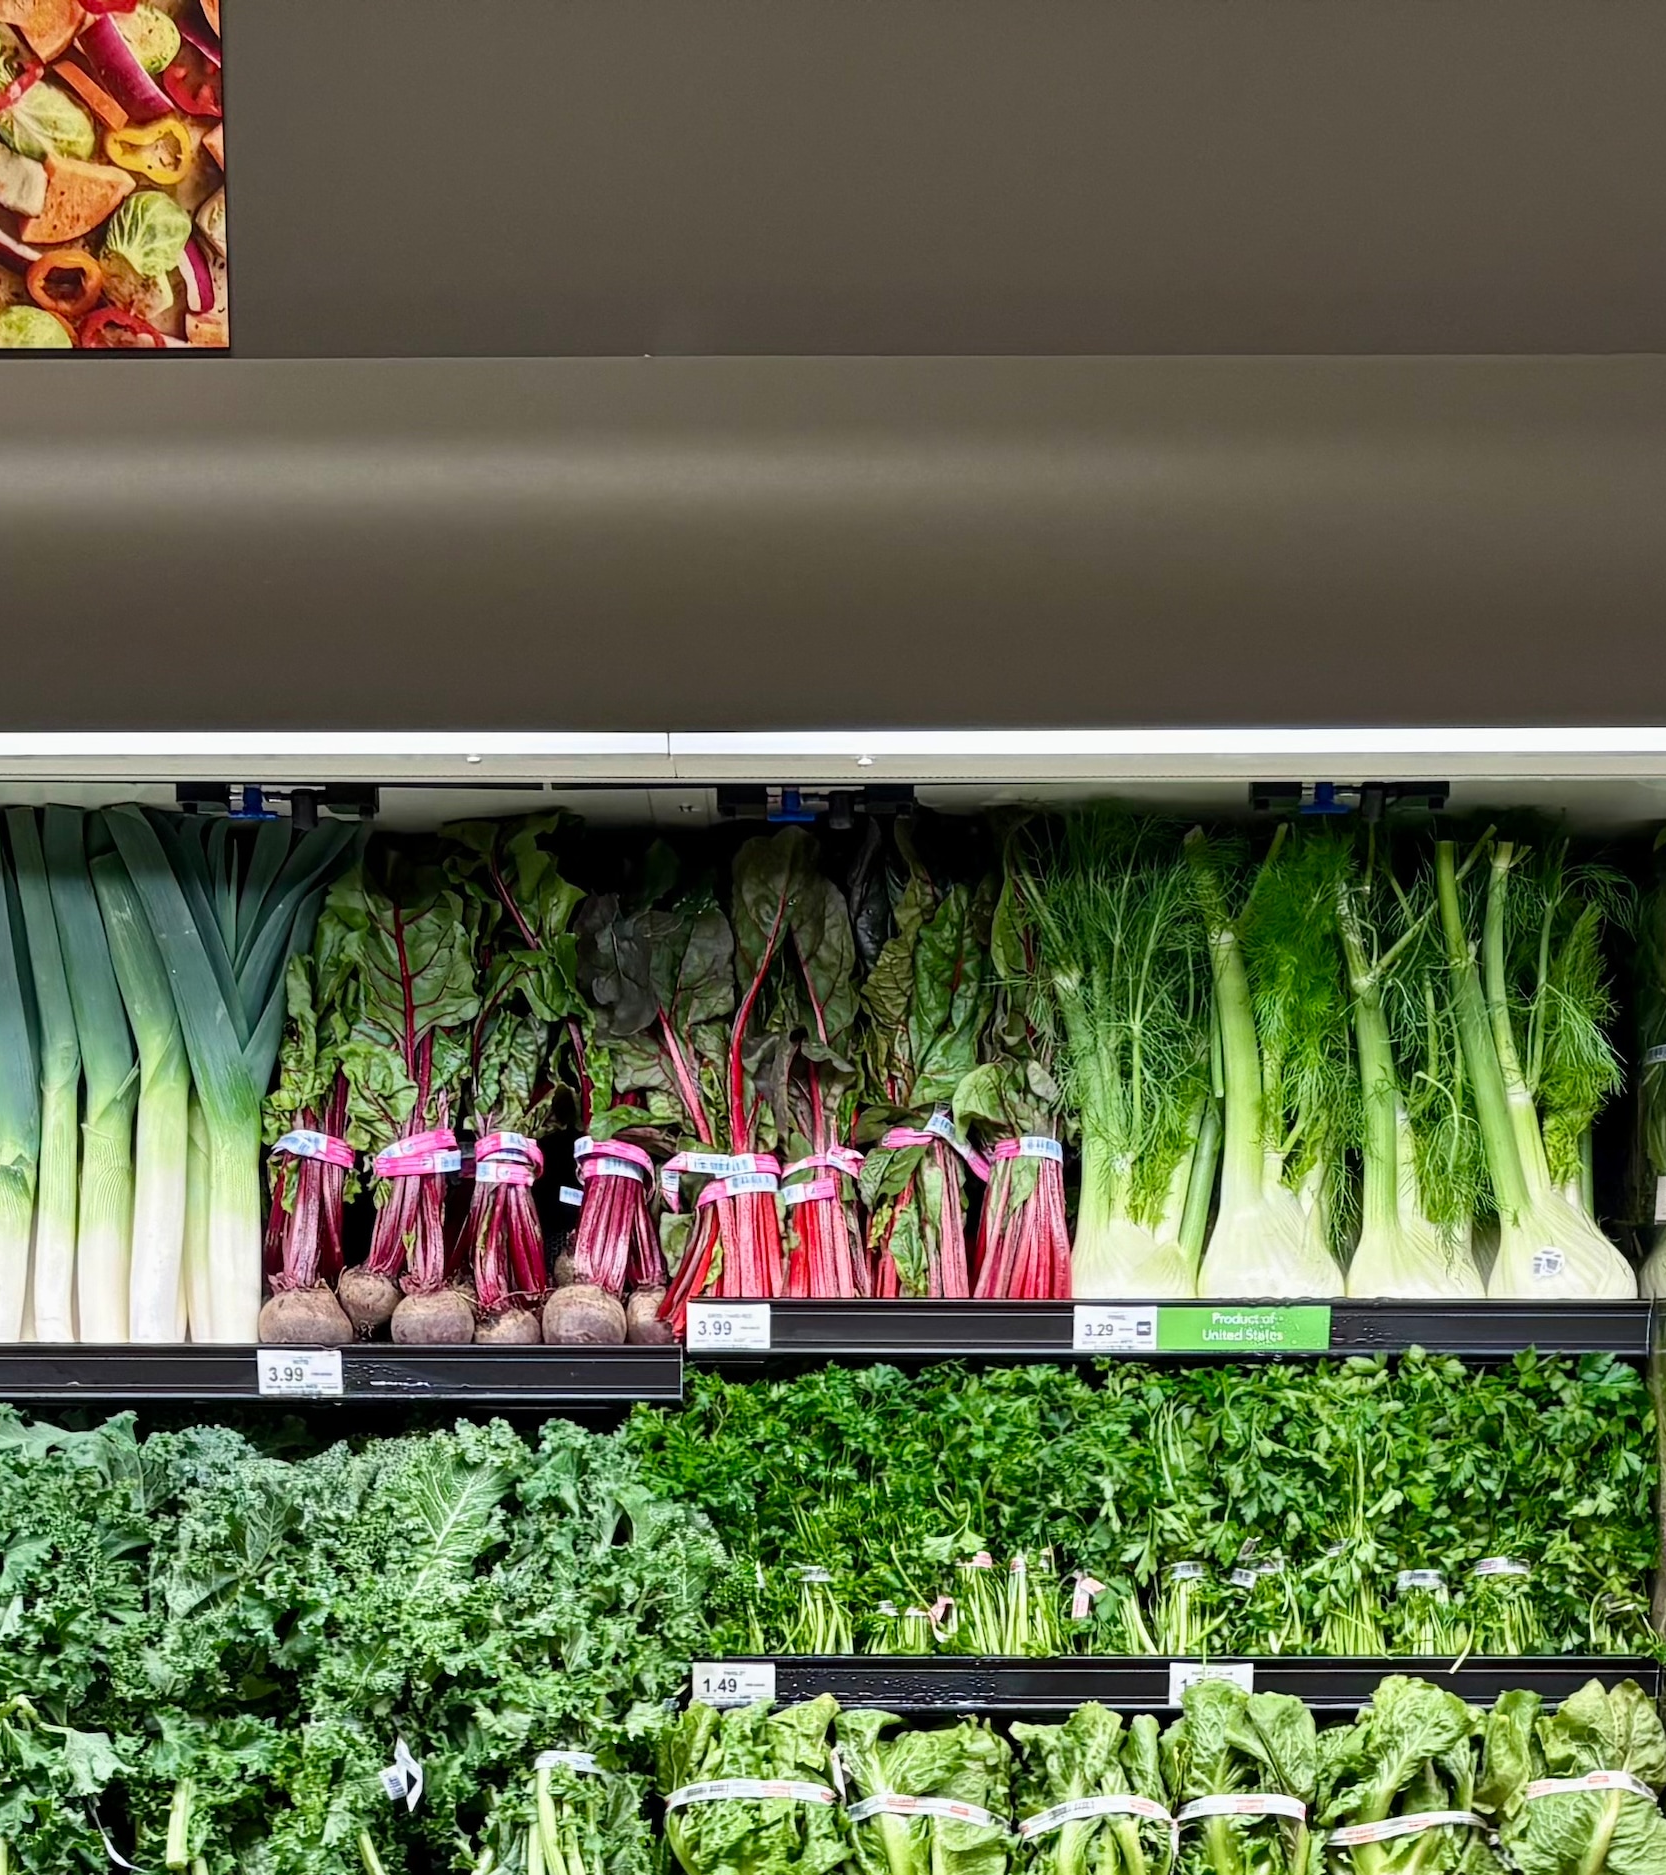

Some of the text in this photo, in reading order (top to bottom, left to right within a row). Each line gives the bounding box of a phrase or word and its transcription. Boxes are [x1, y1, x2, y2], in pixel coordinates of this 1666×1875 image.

[697, 1320, 733, 1336] 3.99
[1083, 1323, 1114, 1336] 3.29
[1202, 1328, 1243, 1341] United
[268, 1366, 304, 1382] 3.99
[702, 1678, 738, 1693] 1.49
